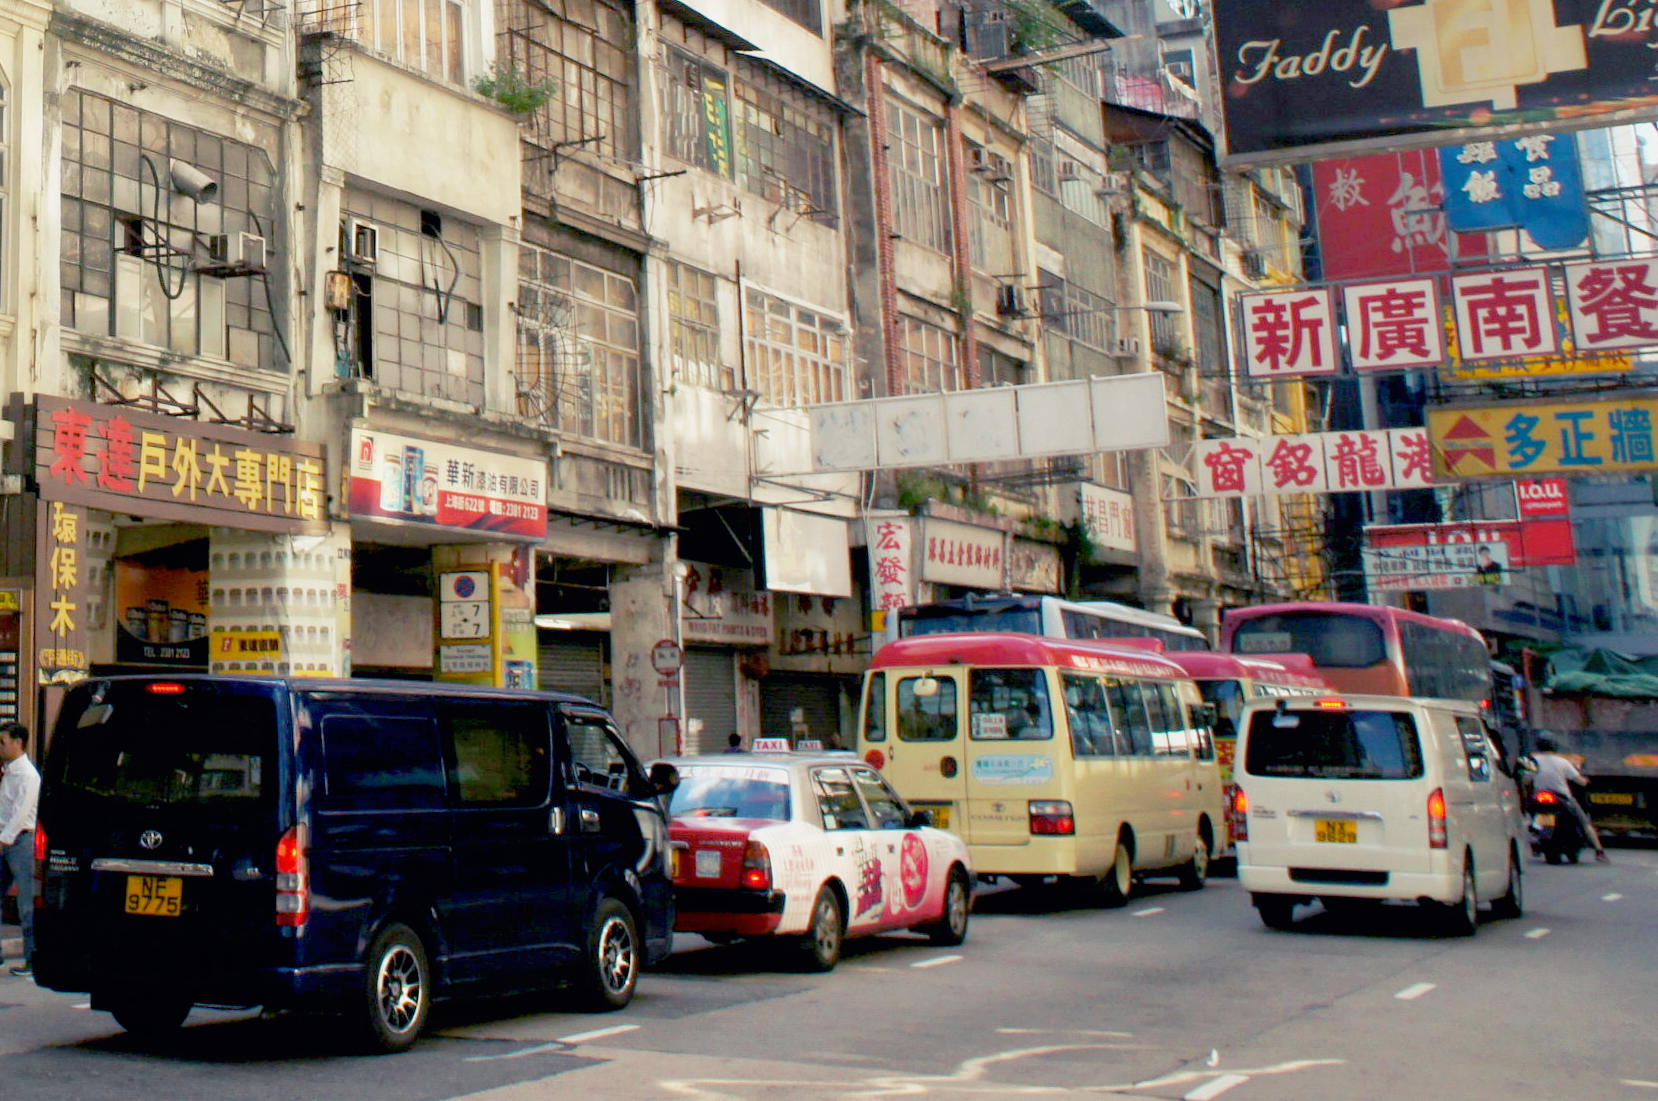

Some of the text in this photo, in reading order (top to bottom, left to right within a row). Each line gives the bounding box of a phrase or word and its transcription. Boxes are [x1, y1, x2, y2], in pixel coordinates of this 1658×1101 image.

[1235, 24, 1388, 88] Faddy
[1251, 263, 1658, 370] 新廣南餐
[755, 740, 784, 750] TAXI
[799, 740, 819, 749] TAXI
[128, 894, 179, 913] 9775
